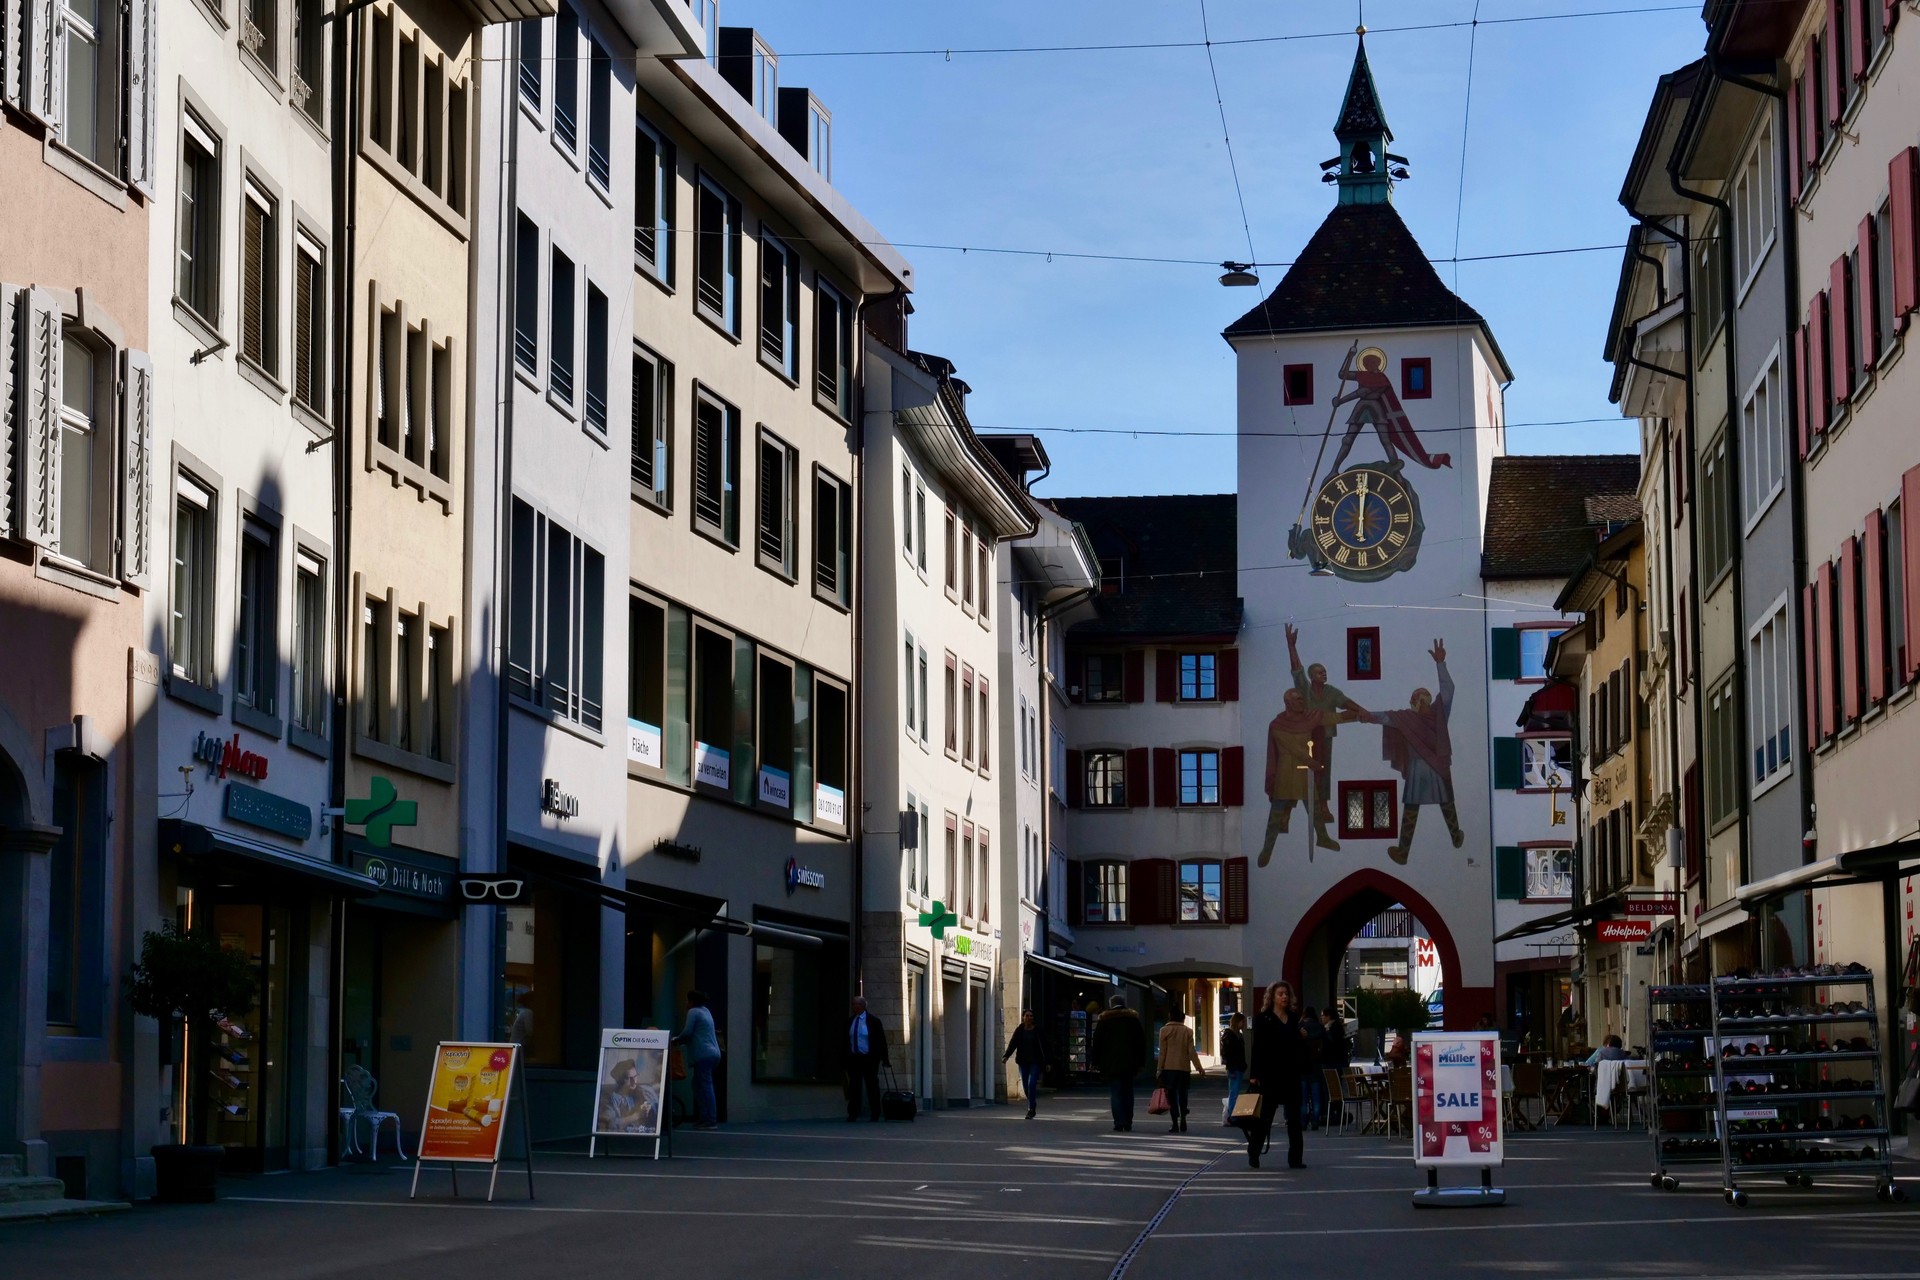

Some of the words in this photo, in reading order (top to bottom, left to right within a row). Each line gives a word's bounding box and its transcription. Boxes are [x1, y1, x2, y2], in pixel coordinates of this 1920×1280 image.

[632, 737, 649, 756] Fläche
[197, 731, 268, 779] toppharm
[698, 763, 703, 773] zu
[704, 762, 727, 781] vermieten
[770, 784, 786, 800] wincasa
[368, 865, 386, 880] OPTIK
[392, 866, 409, 888] Dill
[412, 871, 419, 890] &
[421, 873, 443, 895] Noth
[797, 865, 824, 888] swisscom
[1603, 925, 1648, 939] Hotelplan
[1419, 938, 1433, 952] M
[1419, 954, 1434, 967] M
[1439, 1054, 1475, 1063] Müller
[1437, 1093, 1478, 1107] SALE
